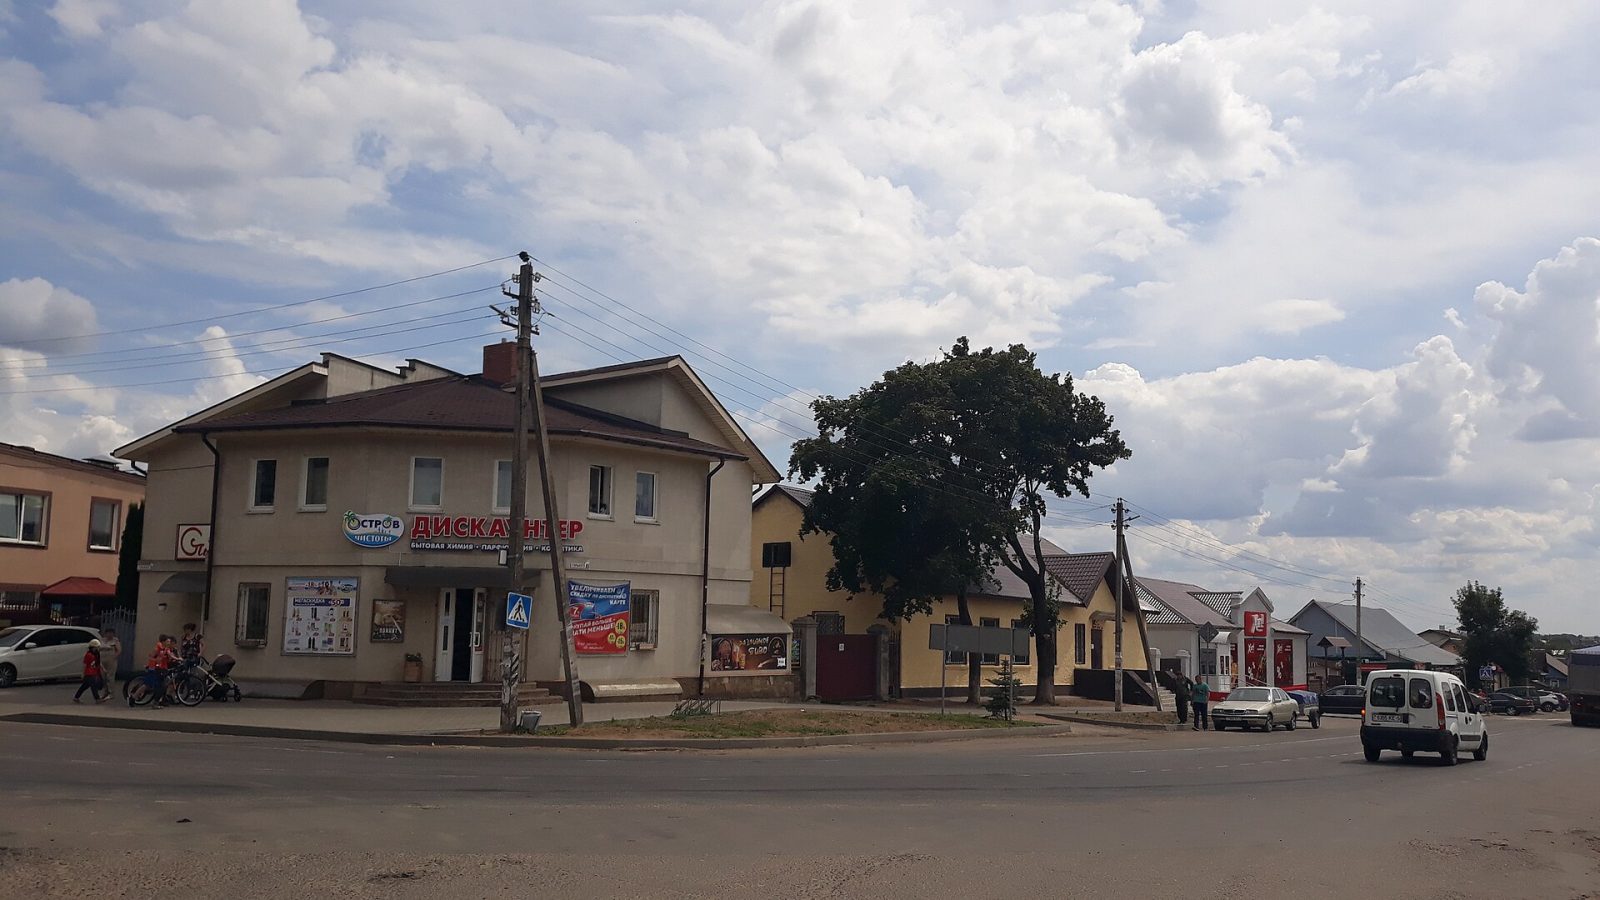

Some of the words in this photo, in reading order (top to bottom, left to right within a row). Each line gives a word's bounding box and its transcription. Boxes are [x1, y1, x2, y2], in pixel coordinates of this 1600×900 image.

[347, 518, 400, 530] ОСТРОВ
[410, 516, 584, 540] ДИСКАНТЕР
[354, 534, 392, 542] ЧИСТОТЫ
